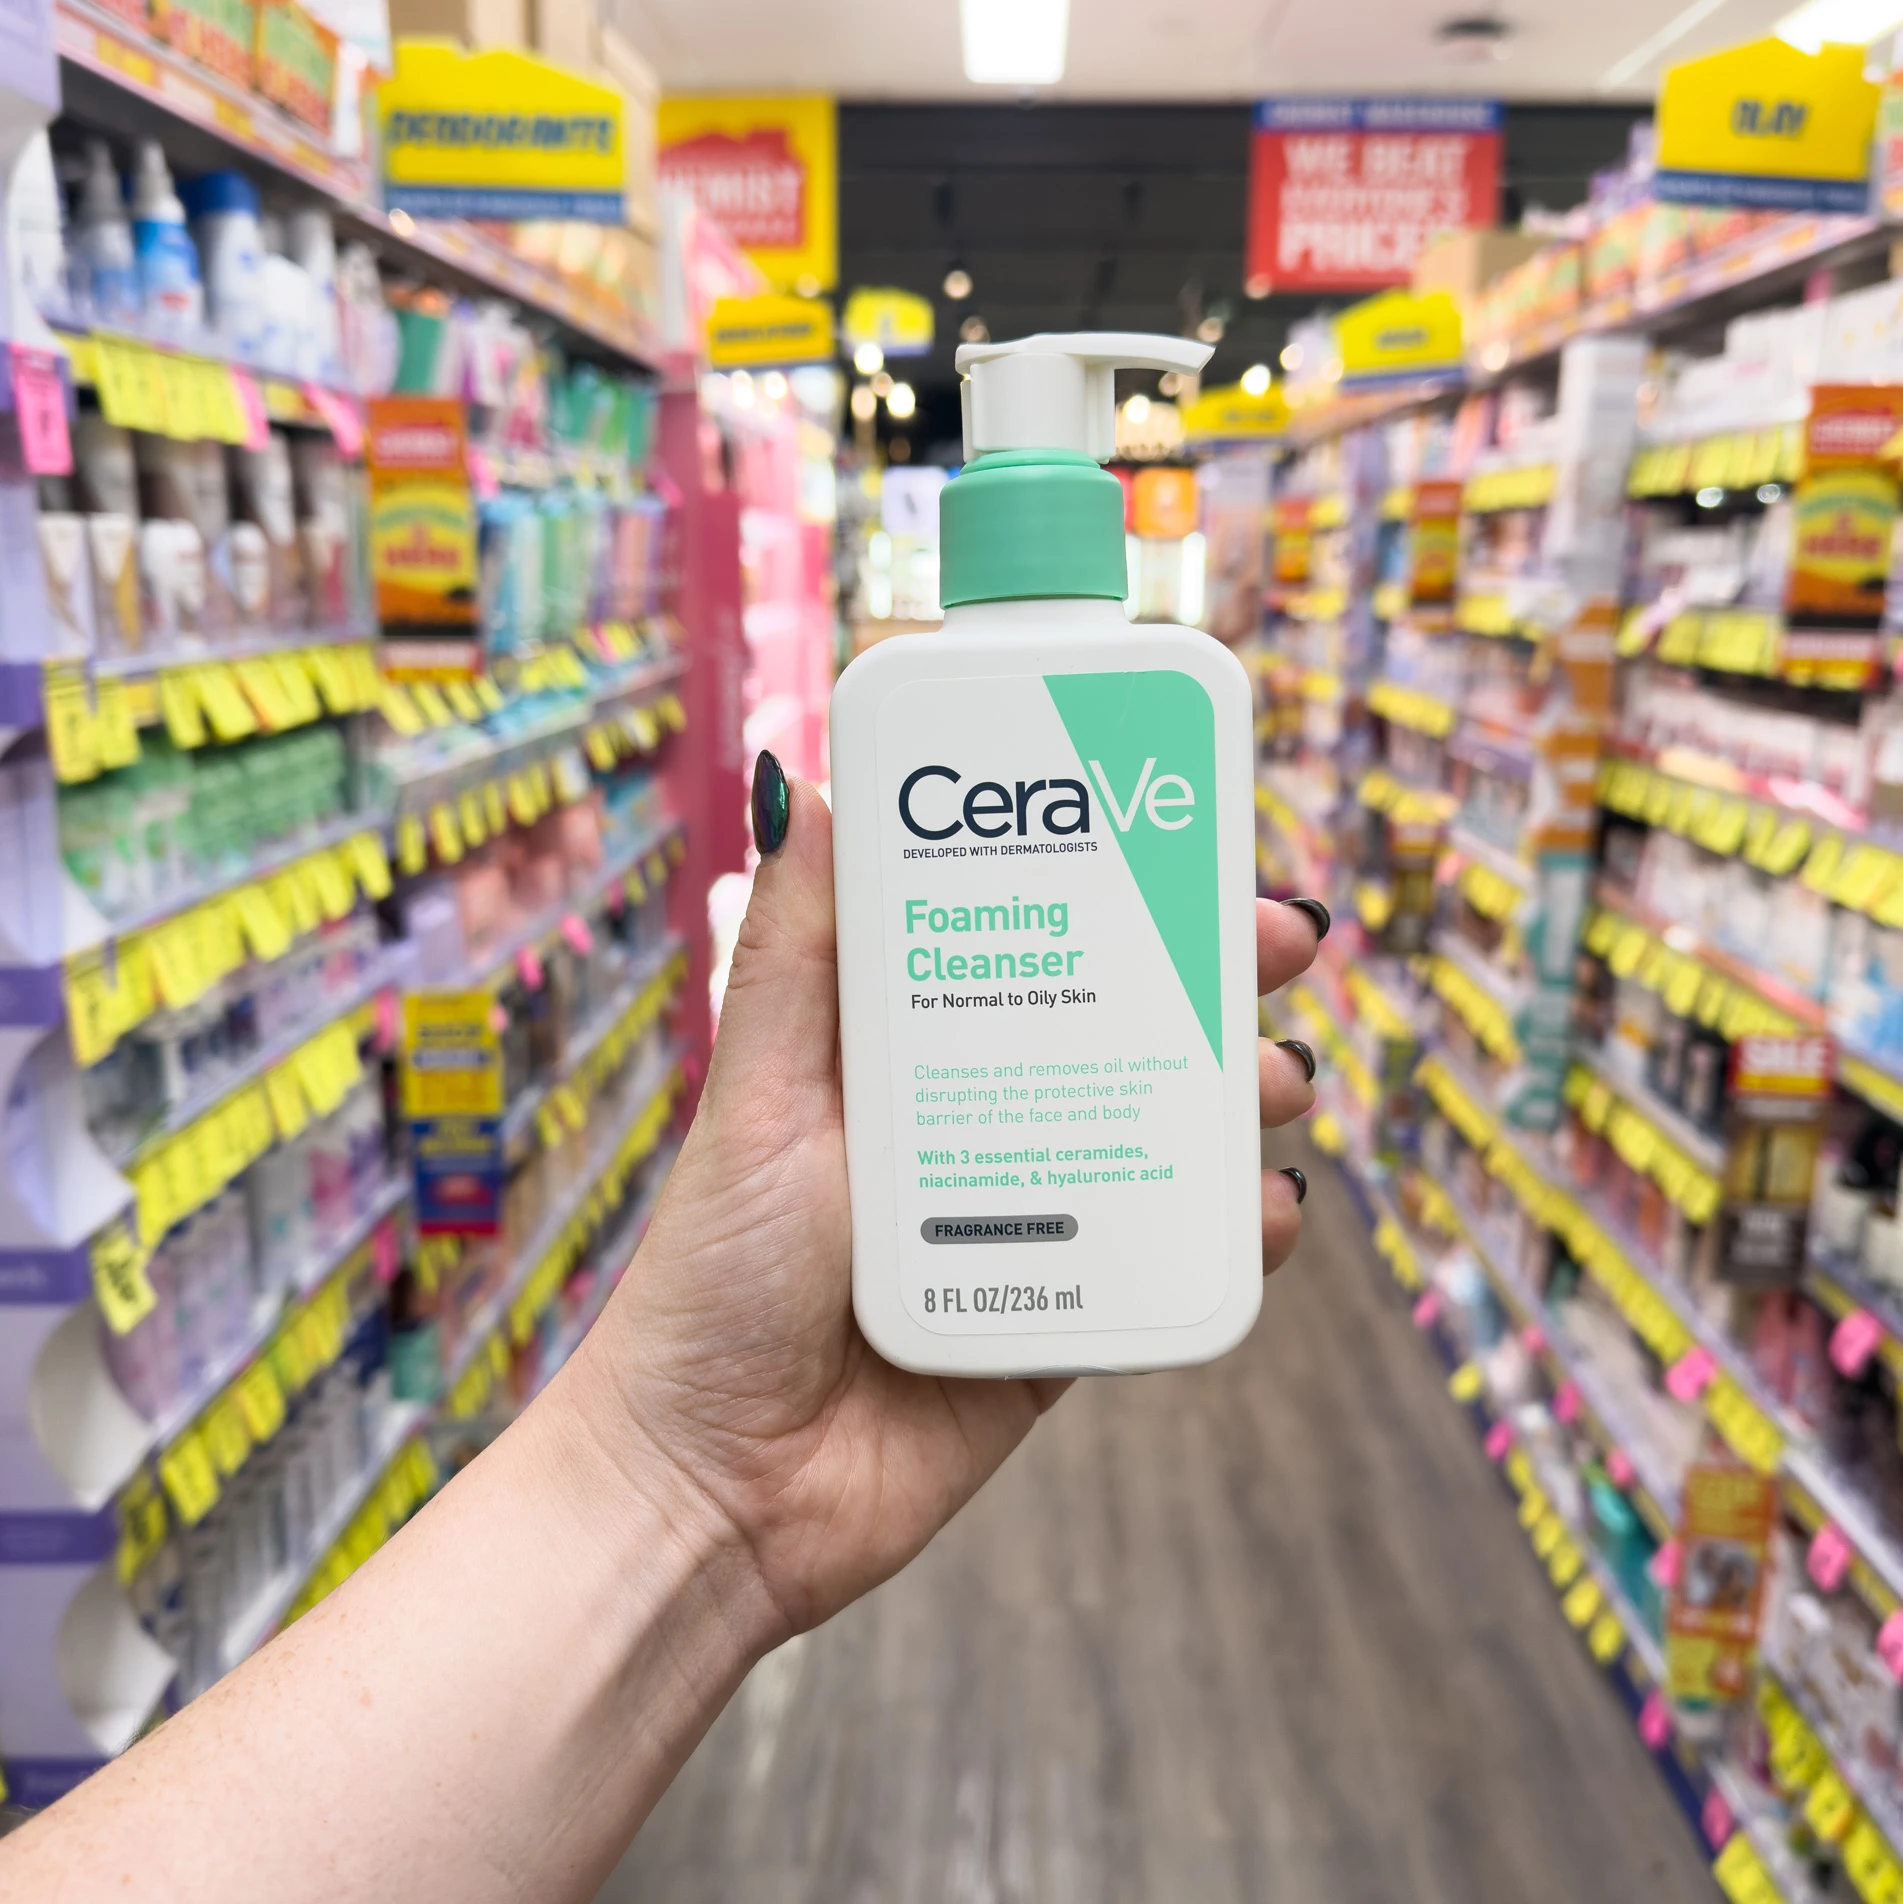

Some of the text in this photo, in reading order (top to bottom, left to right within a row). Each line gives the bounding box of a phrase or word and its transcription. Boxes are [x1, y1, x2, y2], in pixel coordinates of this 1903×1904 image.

[898, 757, 1195, 840] CeraVe
[903, 841, 1098, 859] DEVELOPED WITH DERMATOLOGISTS
[905, 896, 1068, 937] Foaming
[907, 947, 1084, 982] Cleanser
[911, 988, 1096, 1009] For Normal to Oily Skin
[914, 1056, 1188, 1080] Cleanses and removes oil without
[915, 1080, 1153, 1105] disrupting the protective skin
[916, 1103, 1141, 1126] barrier of the face and body
[917, 1144, 1149, 1165] With 3 essential ceramides,
[919, 1164, 1174, 1189] niacinamide, & hyaluronic acid
[935, 1221, 1065, 1237] FRAGRANCE FREE
[924, 1284, 1083, 1314] 8 FL OZ/236 ml
